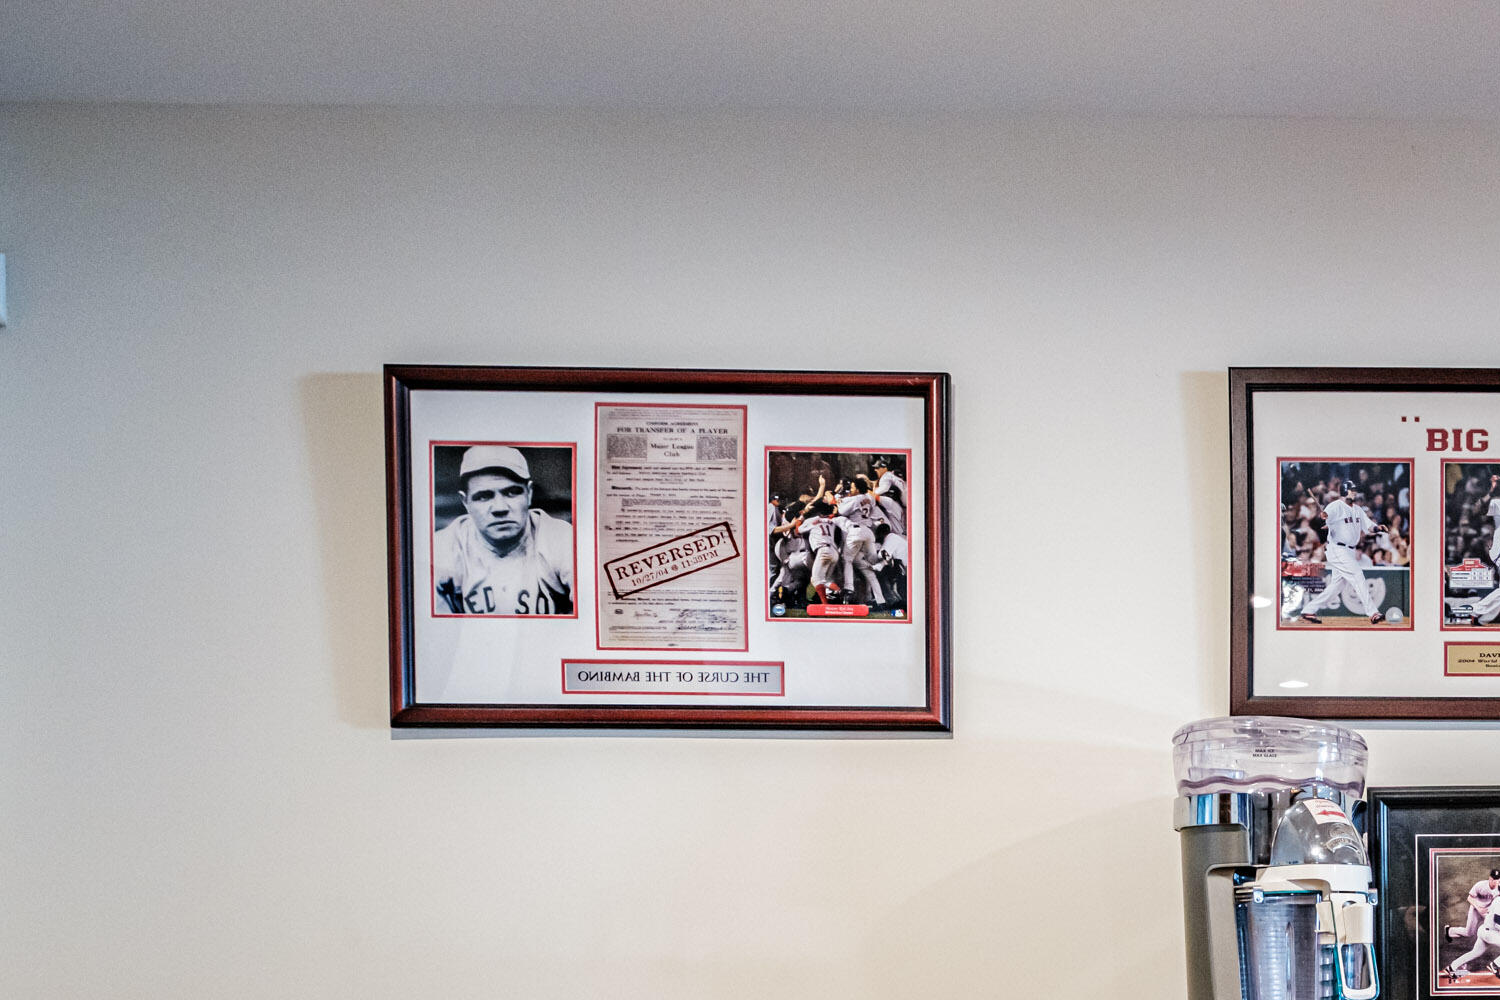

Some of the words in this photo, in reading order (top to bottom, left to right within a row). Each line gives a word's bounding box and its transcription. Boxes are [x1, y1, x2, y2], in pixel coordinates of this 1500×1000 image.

[819, 525, 832, 537] 11
[614, 531, 728, 581] REVERSED!
[631, 567, 669, 587] 10/27/04
